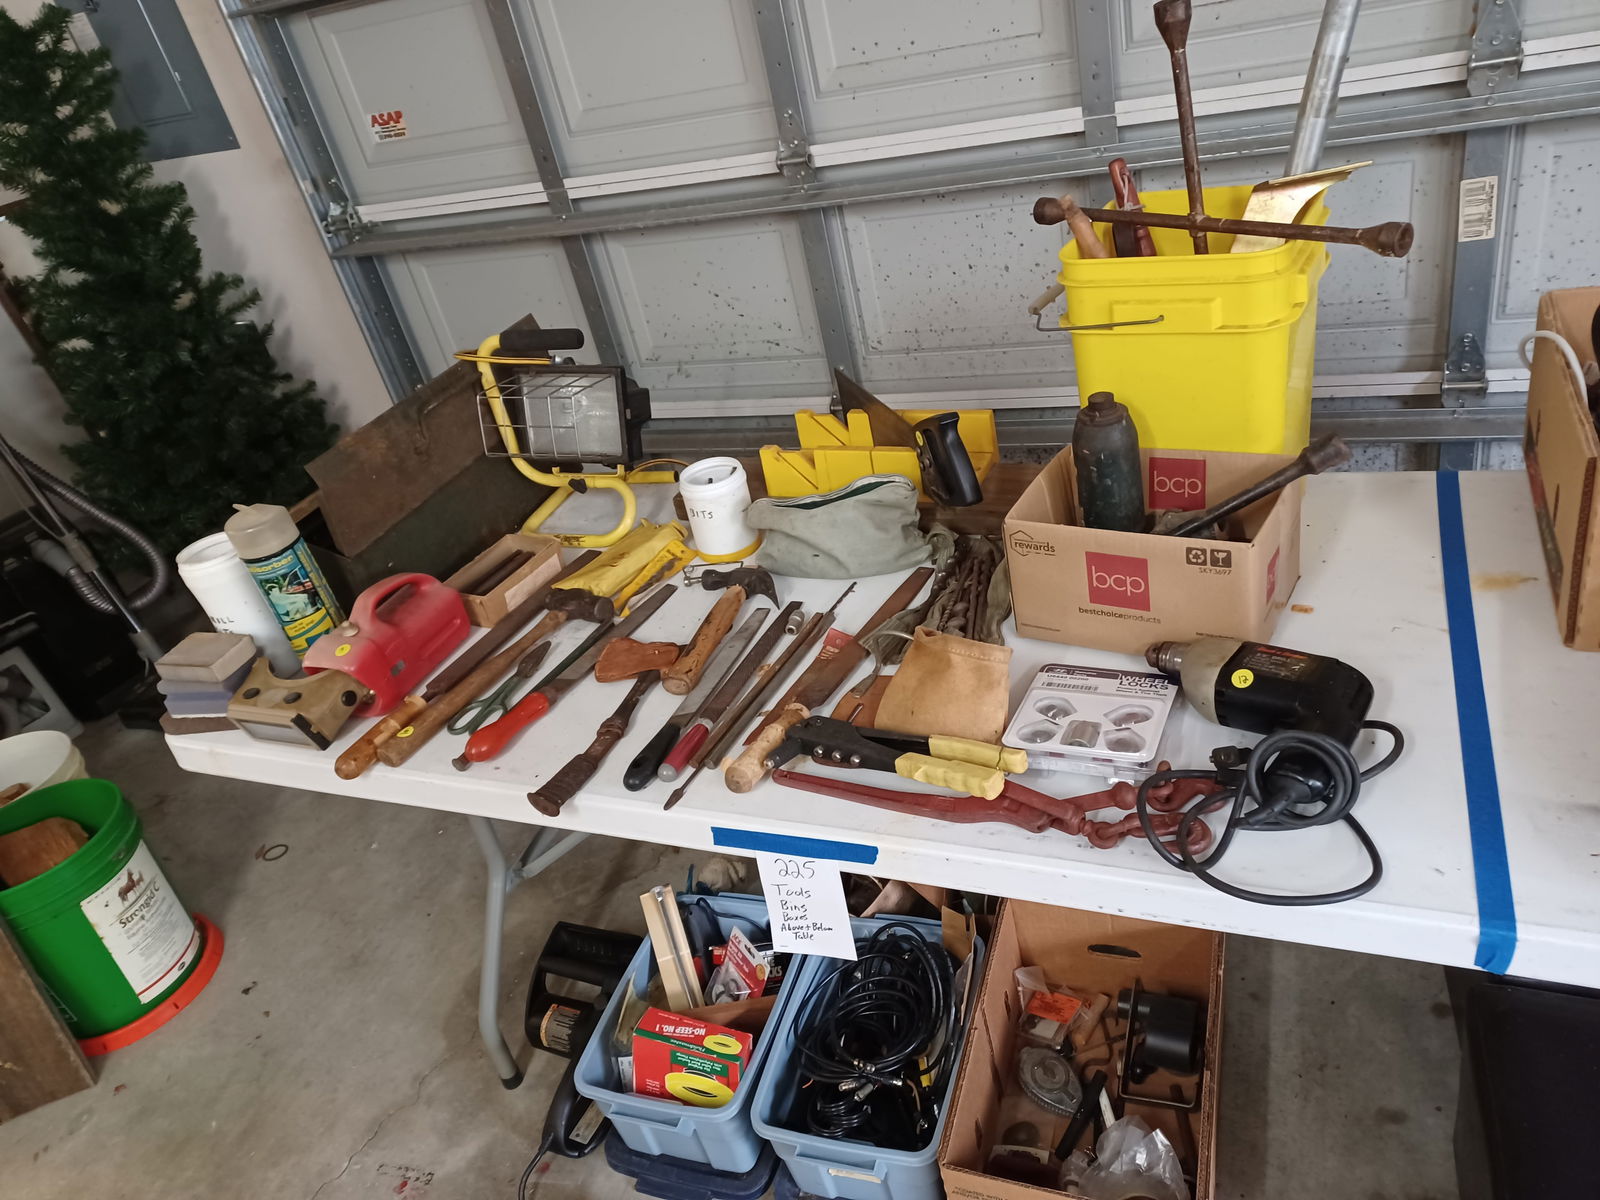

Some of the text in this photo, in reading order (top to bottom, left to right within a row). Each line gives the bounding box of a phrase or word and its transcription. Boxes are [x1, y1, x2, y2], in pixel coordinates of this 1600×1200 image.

[371, 110, 403, 128] ASAP
[1154, 470, 1202, 498] bcp
[1014, 541, 1056, 553] rewards
[1092, 565, 1145, 596] bcp
[1078, 606, 1161, 624] bestchoiceproducts
[1119, 680, 1169, 690] LOCKS
[1121, 675, 1169, 685] WHEEL
[774, 858, 816, 879] 225
[770, 883, 812, 899] Tools
[119, 889, 157, 929] Strongid
[780, 899, 808, 913] Bins
[783, 911, 808, 922] Boxes
[792, 931, 814, 941] Table
[661, 1024, 675, 1033] NO.
[675, 1026, 706, 1036] NO-SEEP
